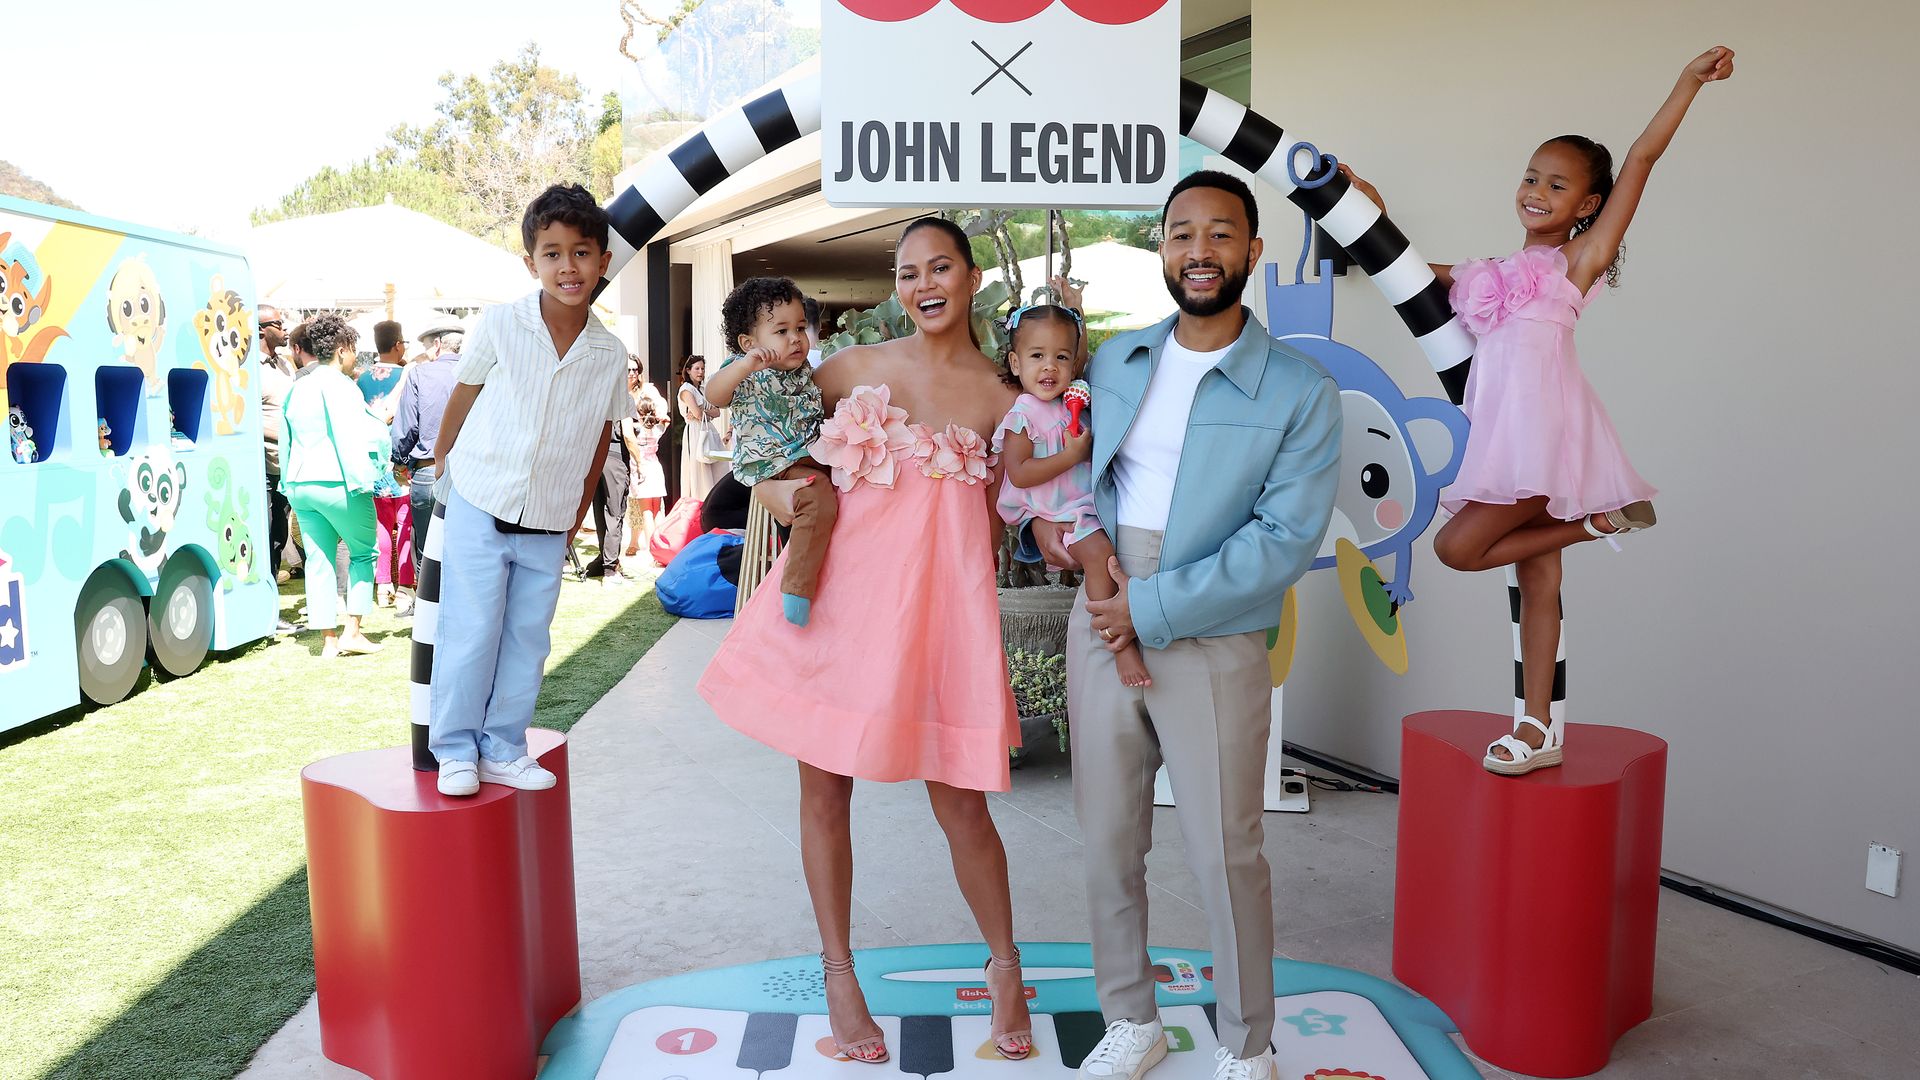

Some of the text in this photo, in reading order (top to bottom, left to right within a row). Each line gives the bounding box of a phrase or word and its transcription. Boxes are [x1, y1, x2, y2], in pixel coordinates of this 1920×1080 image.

[834, 120, 1167, 184] JOHN LEGEND
[1303, 1014, 1332, 1032] 5
[677, 1031, 696, 1051] 1
